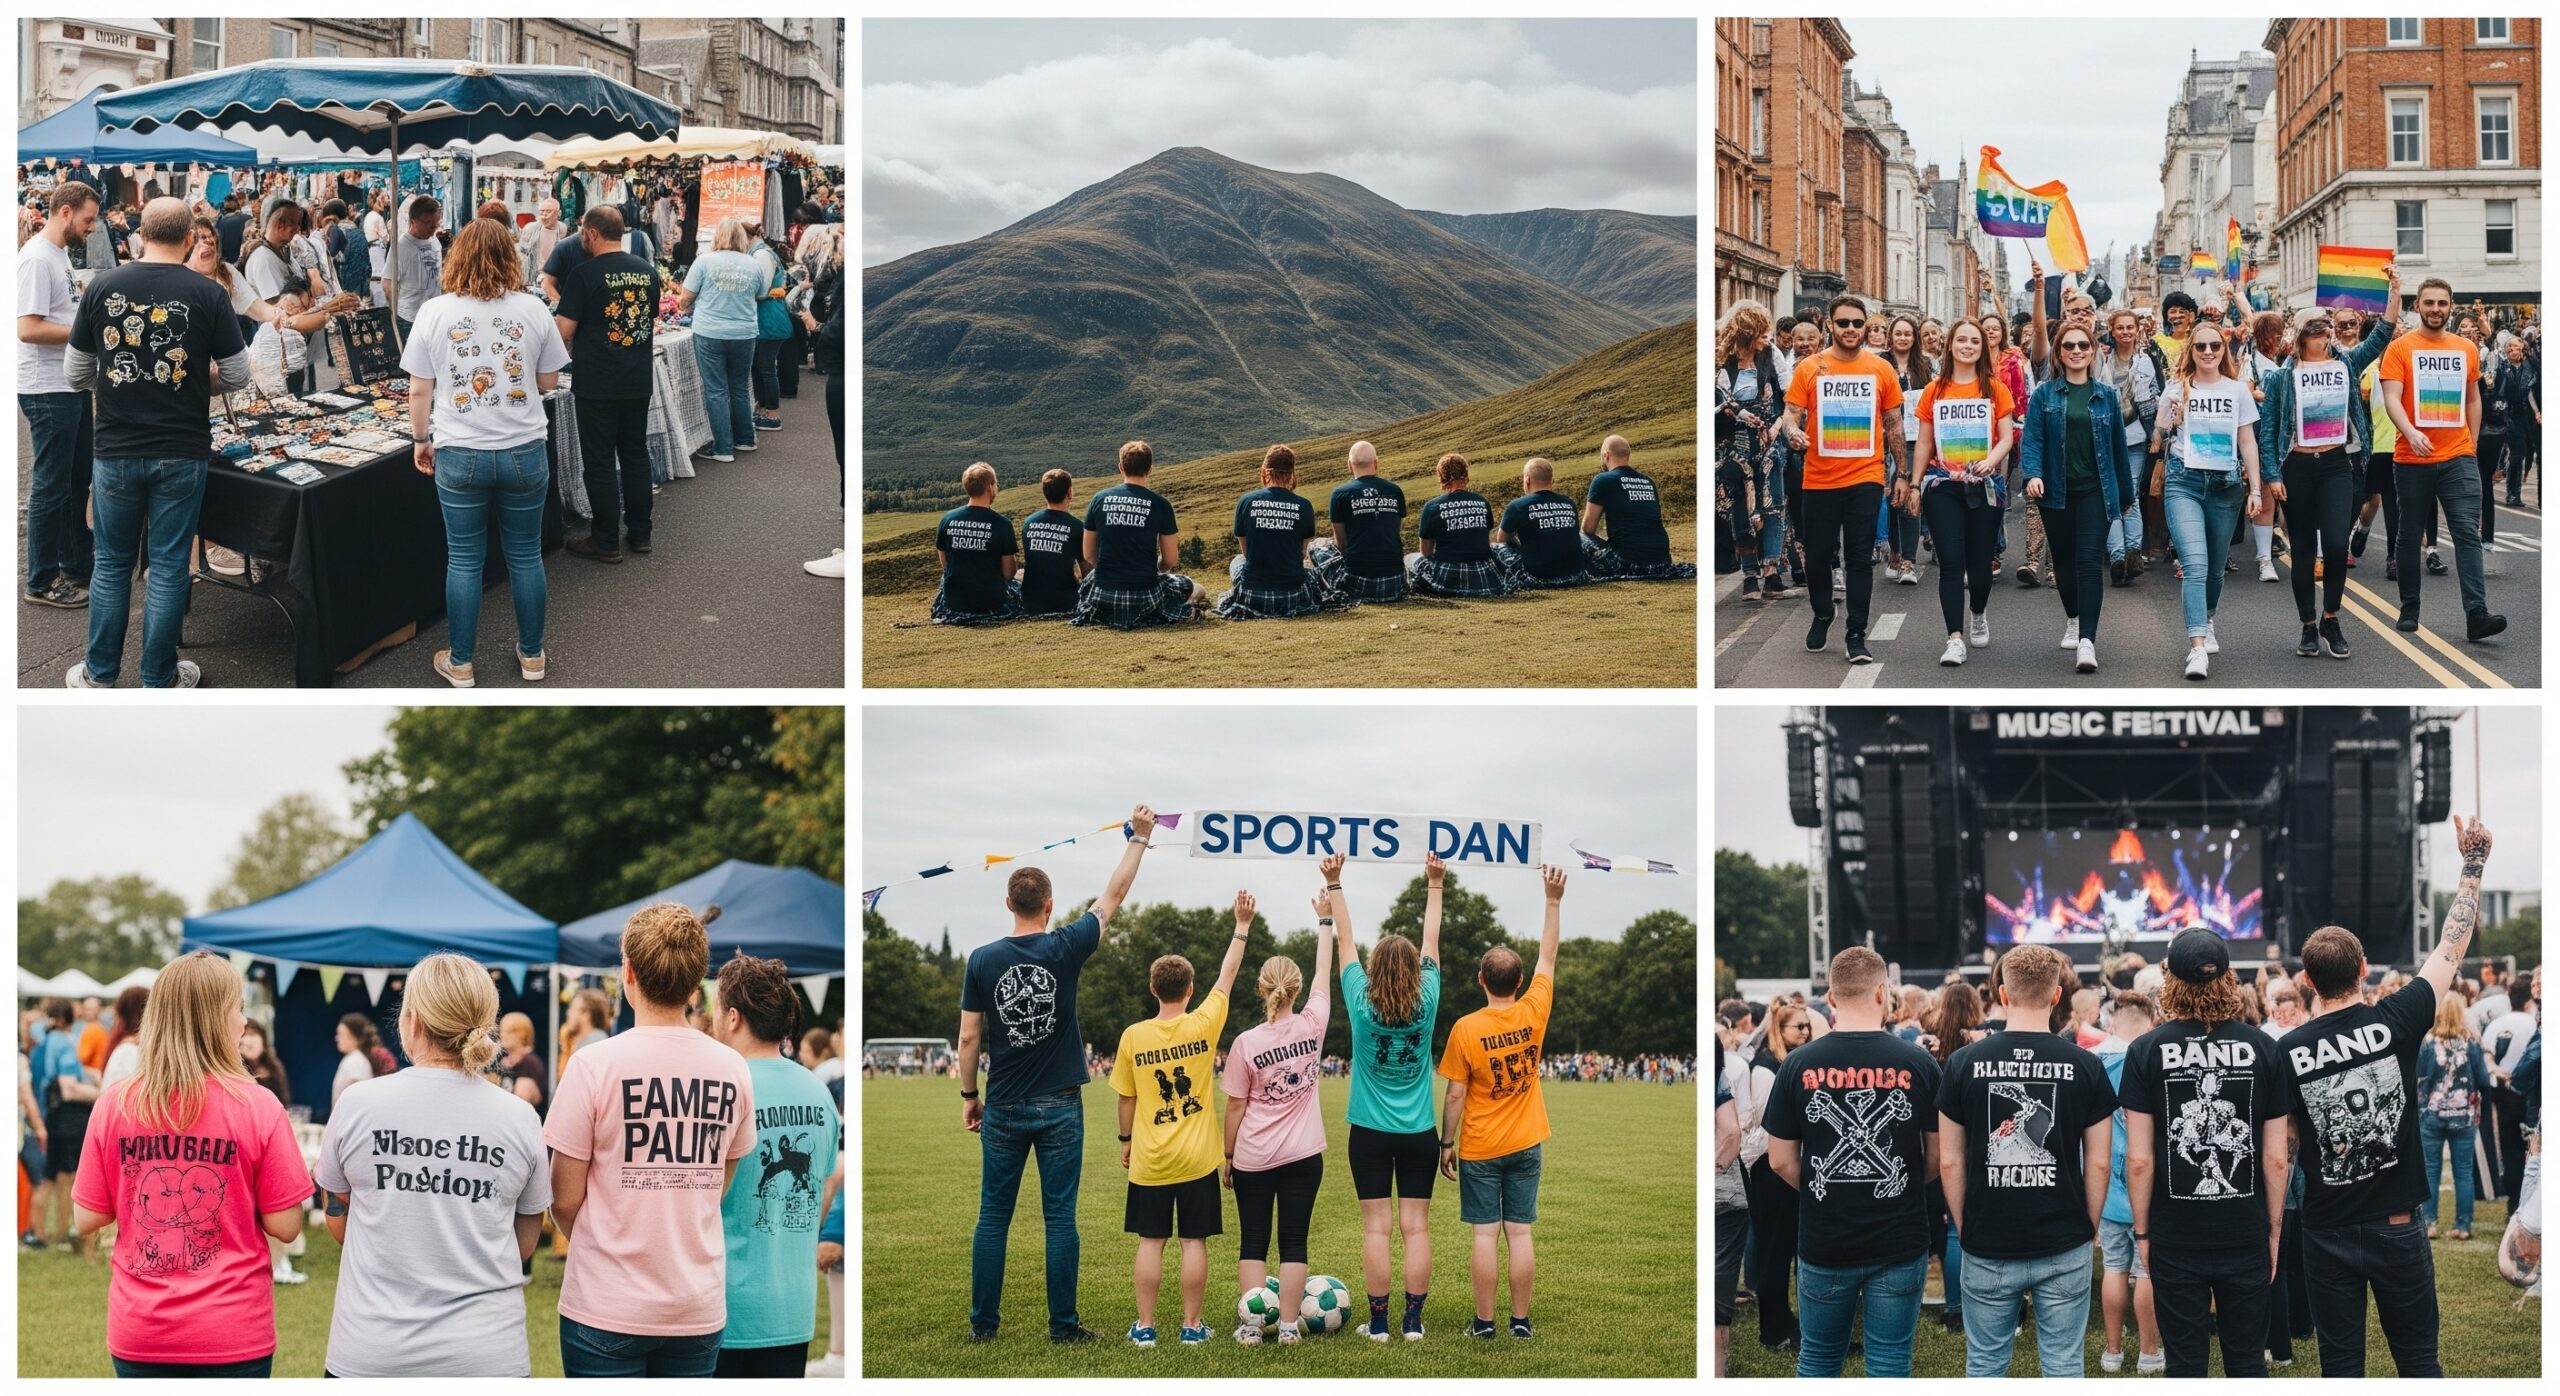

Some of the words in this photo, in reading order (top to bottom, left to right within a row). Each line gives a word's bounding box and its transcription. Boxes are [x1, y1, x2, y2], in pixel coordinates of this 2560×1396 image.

[1997, 710, 2106, 738] MUSIC
[1200, 812, 1401, 859] SPORTS
[1428, 820, 1531, 865] DAN
[2159, 1041, 2258, 1071] BAND
[2289, 1022, 2393, 1077] BAND
[621, 1077, 738, 1124] EAMER
[456, 1134, 506, 1168] ths
